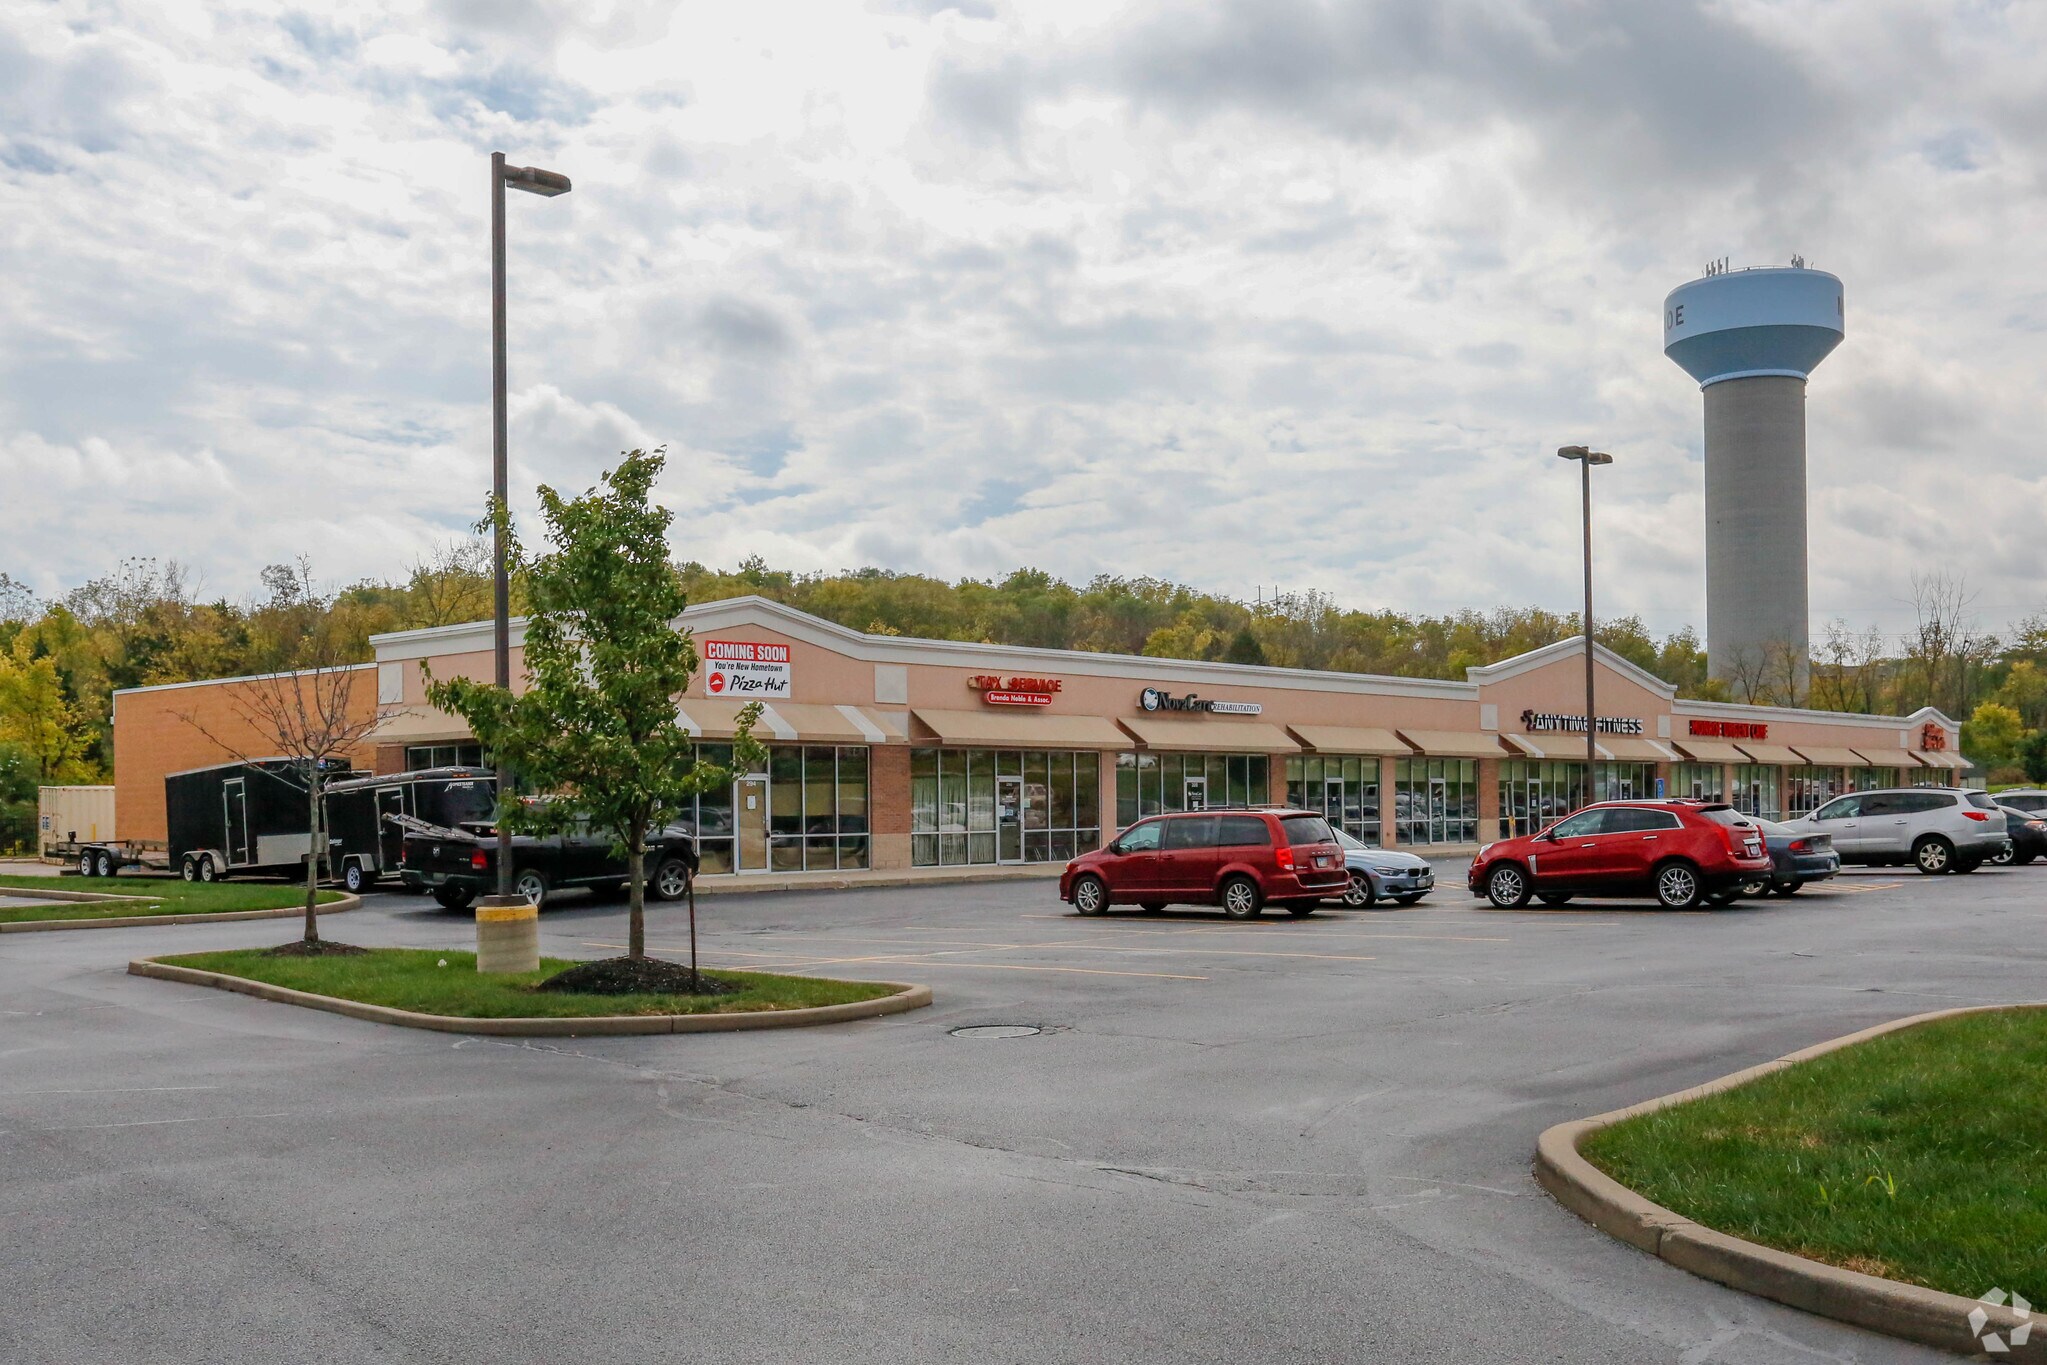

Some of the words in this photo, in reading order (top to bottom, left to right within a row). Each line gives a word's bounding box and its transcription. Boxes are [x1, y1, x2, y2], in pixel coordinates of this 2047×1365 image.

[707, 642, 755, 660] COMING
[757, 645, 787, 662] SOON
[714, 661, 735, 670] You're
[735, 663, 751, 671] New
[750, 663, 783, 672] Hometown
[729, 674, 763, 691] Pizza
[764, 677, 788, 691] Hut
[975, 675, 1002, 690] TAX
[1008, 676, 1062, 693] SERVICE
[990, 693, 1010, 702] Brenda
[1033, 696, 1050, 704] Assoc.
[1212, 702, 1260, 713] REHABILITATION
[1535, 713, 1588, 732] ANYTIME
[1594, 716, 1644, 735] FITNESS
